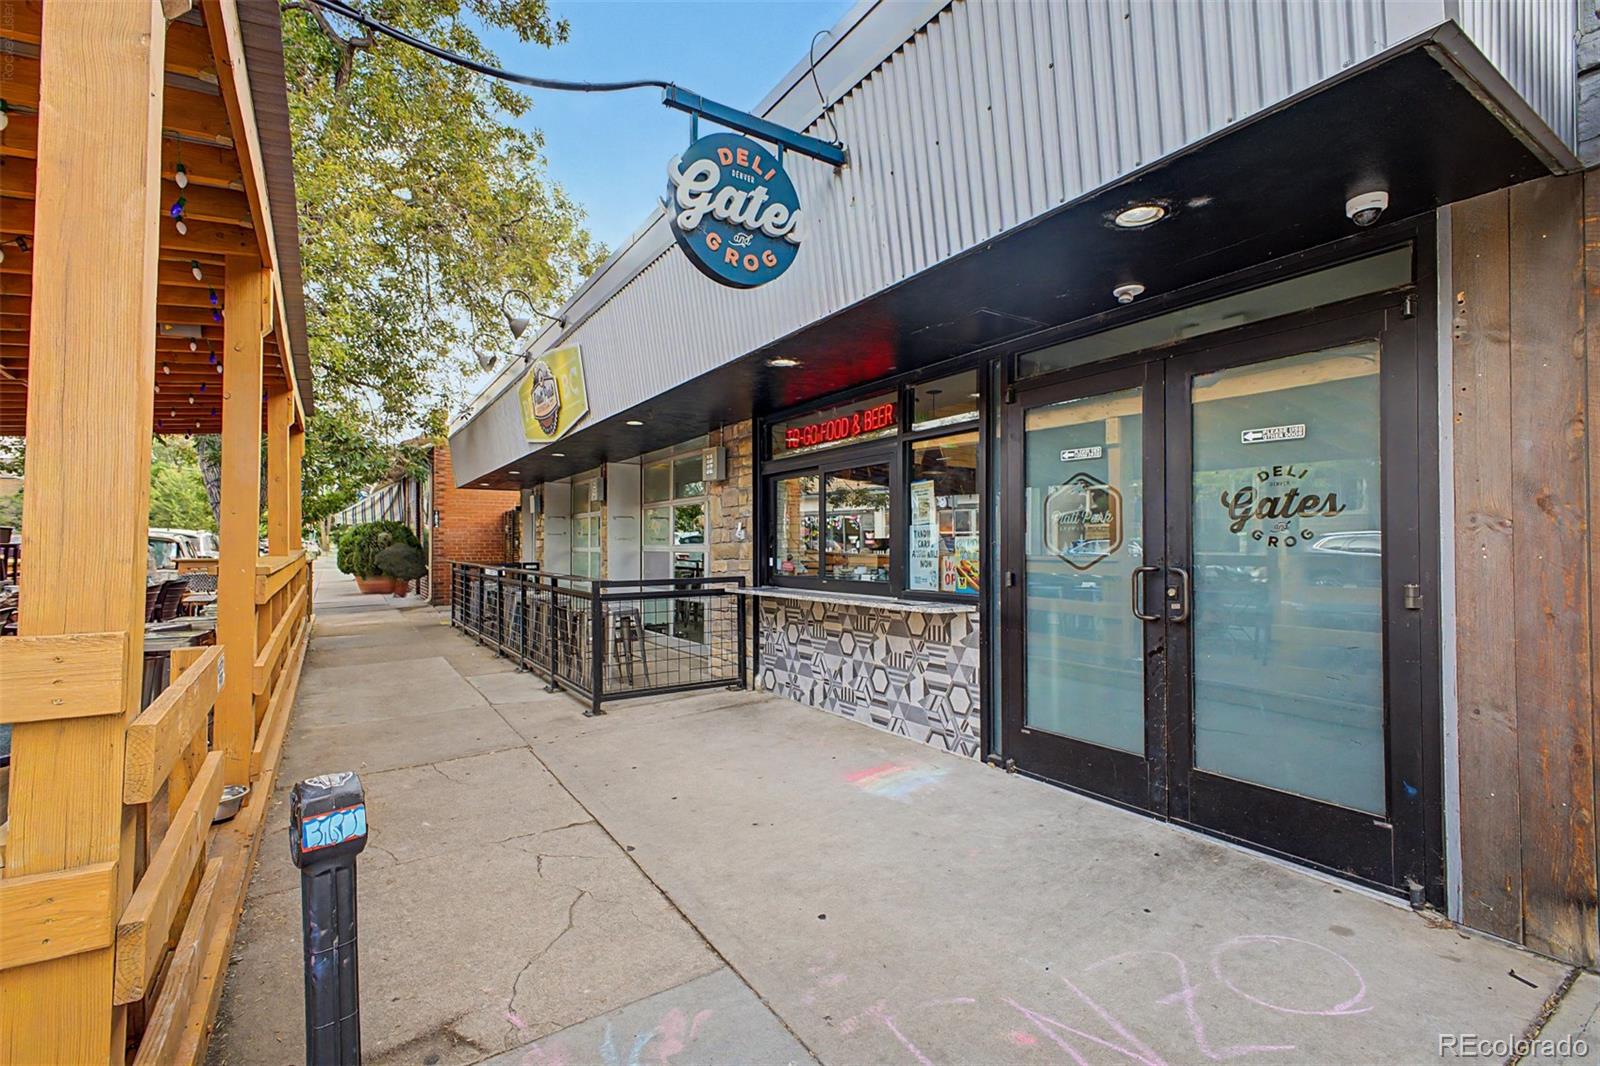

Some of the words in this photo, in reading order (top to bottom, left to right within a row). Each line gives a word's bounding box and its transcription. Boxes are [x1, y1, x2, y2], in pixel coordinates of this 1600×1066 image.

[717, 147, 776, 181] DELI
[731, 169, 755, 184] DENVER
[667, 154, 802, 244] Gates
[705, 232, 777, 272] GROG
[728, 232, 753, 248] and
[820, 417, 849, 441] FOOD
[852, 414, 860, 434] &
[864, 403, 893, 431] BEER
[1257, 465, 1308, 482] DELI
[1221, 486, 1346, 533] Gates
[1251, 529, 1314, 547] GROG
